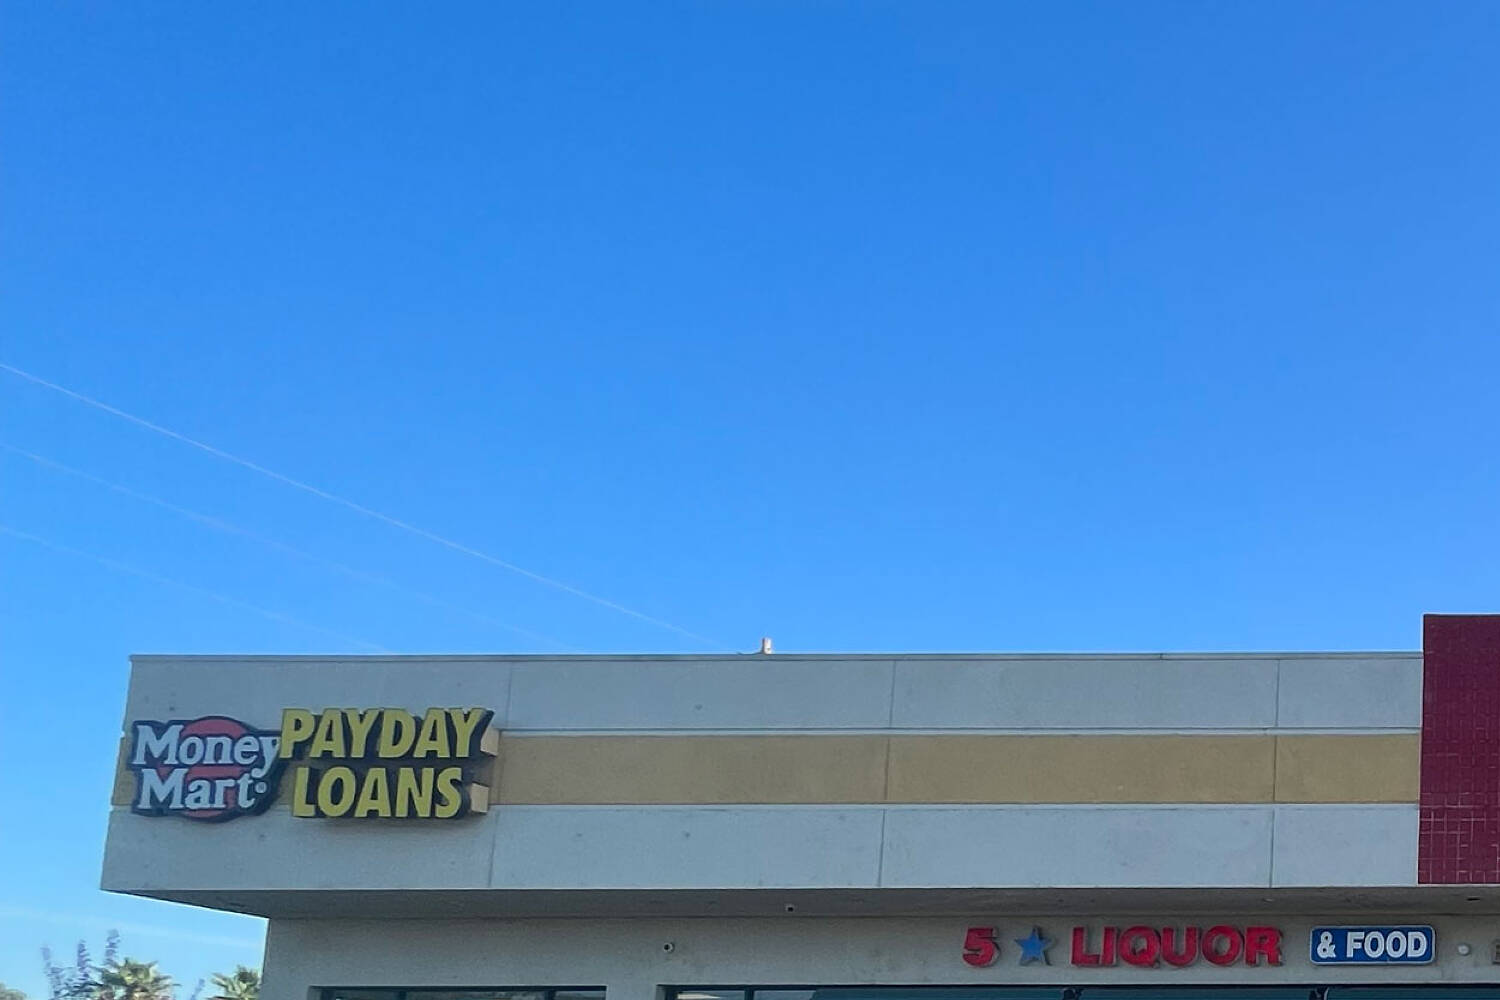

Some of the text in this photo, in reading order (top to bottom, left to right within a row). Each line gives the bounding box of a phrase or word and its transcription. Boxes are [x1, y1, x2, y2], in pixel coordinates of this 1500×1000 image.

[134, 721, 283, 775] Money
[279, 706, 489, 759] PAYDAY
[136, 768, 256, 811] Mart
[292, 766, 464, 819] LOANS
[962, 926, 1284, 968] 5 LIQUOR
[1316, 931, 1429, 959] & FOOD
